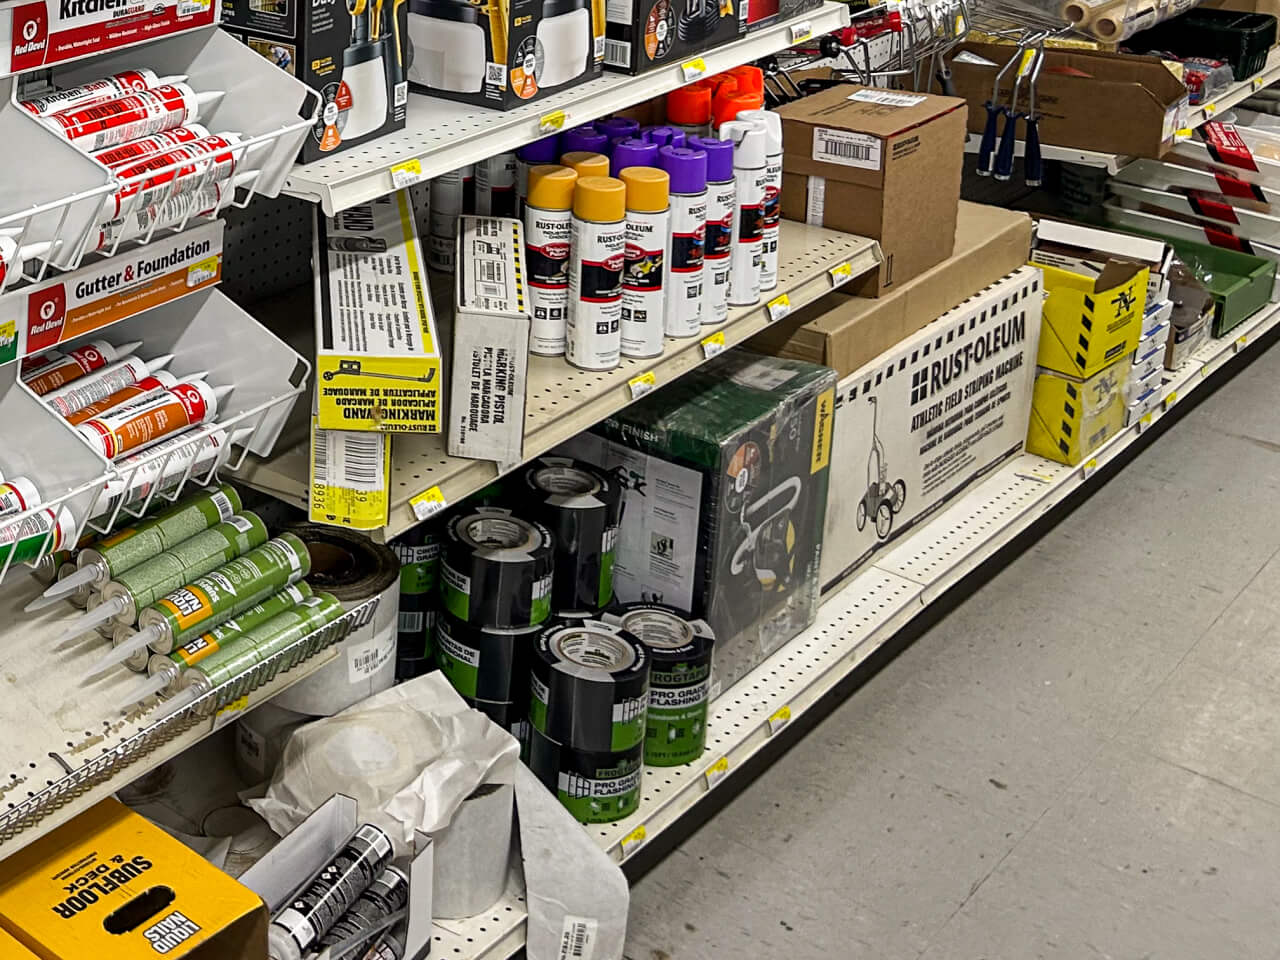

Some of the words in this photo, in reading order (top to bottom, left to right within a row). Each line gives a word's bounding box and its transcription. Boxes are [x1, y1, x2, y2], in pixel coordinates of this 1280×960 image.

[14, 43, 28, 56] Red
[29, 39, 46, 53] Devil
[75, 273, 121, 299] Gutter
[123, 265, 134, 282] &
[136, 239, 210, 277] Foundation
[930, 311, 1025, 395] RUST-OLEUM
[370, 388, 380, 396] DE
[378, 398, 387, 406] DE
[383, 389, 436, 398] APPLICATEUR
[391, 399, 436, 407] APLICADOR
[911, 401, 943, 433] ATHLETIC
[945, 389, 963, 413] FIELD
[965, 369, 994, 398] STRIPING
[995, 351, 1023, 380] MACHINE
[493, 394, 505, 424] PISTOL
[650, 694, 701, 706] FLASHING
[651, 690, 675, 700] PRO
[110, 854, 124, 864] &
[51, 855, 153, 919] SUBFLOOR
[63, 863, 110, 894] DECK
[143, 910, 188, 942] NAILS
[152, 920, 202, 954] LIQUID
